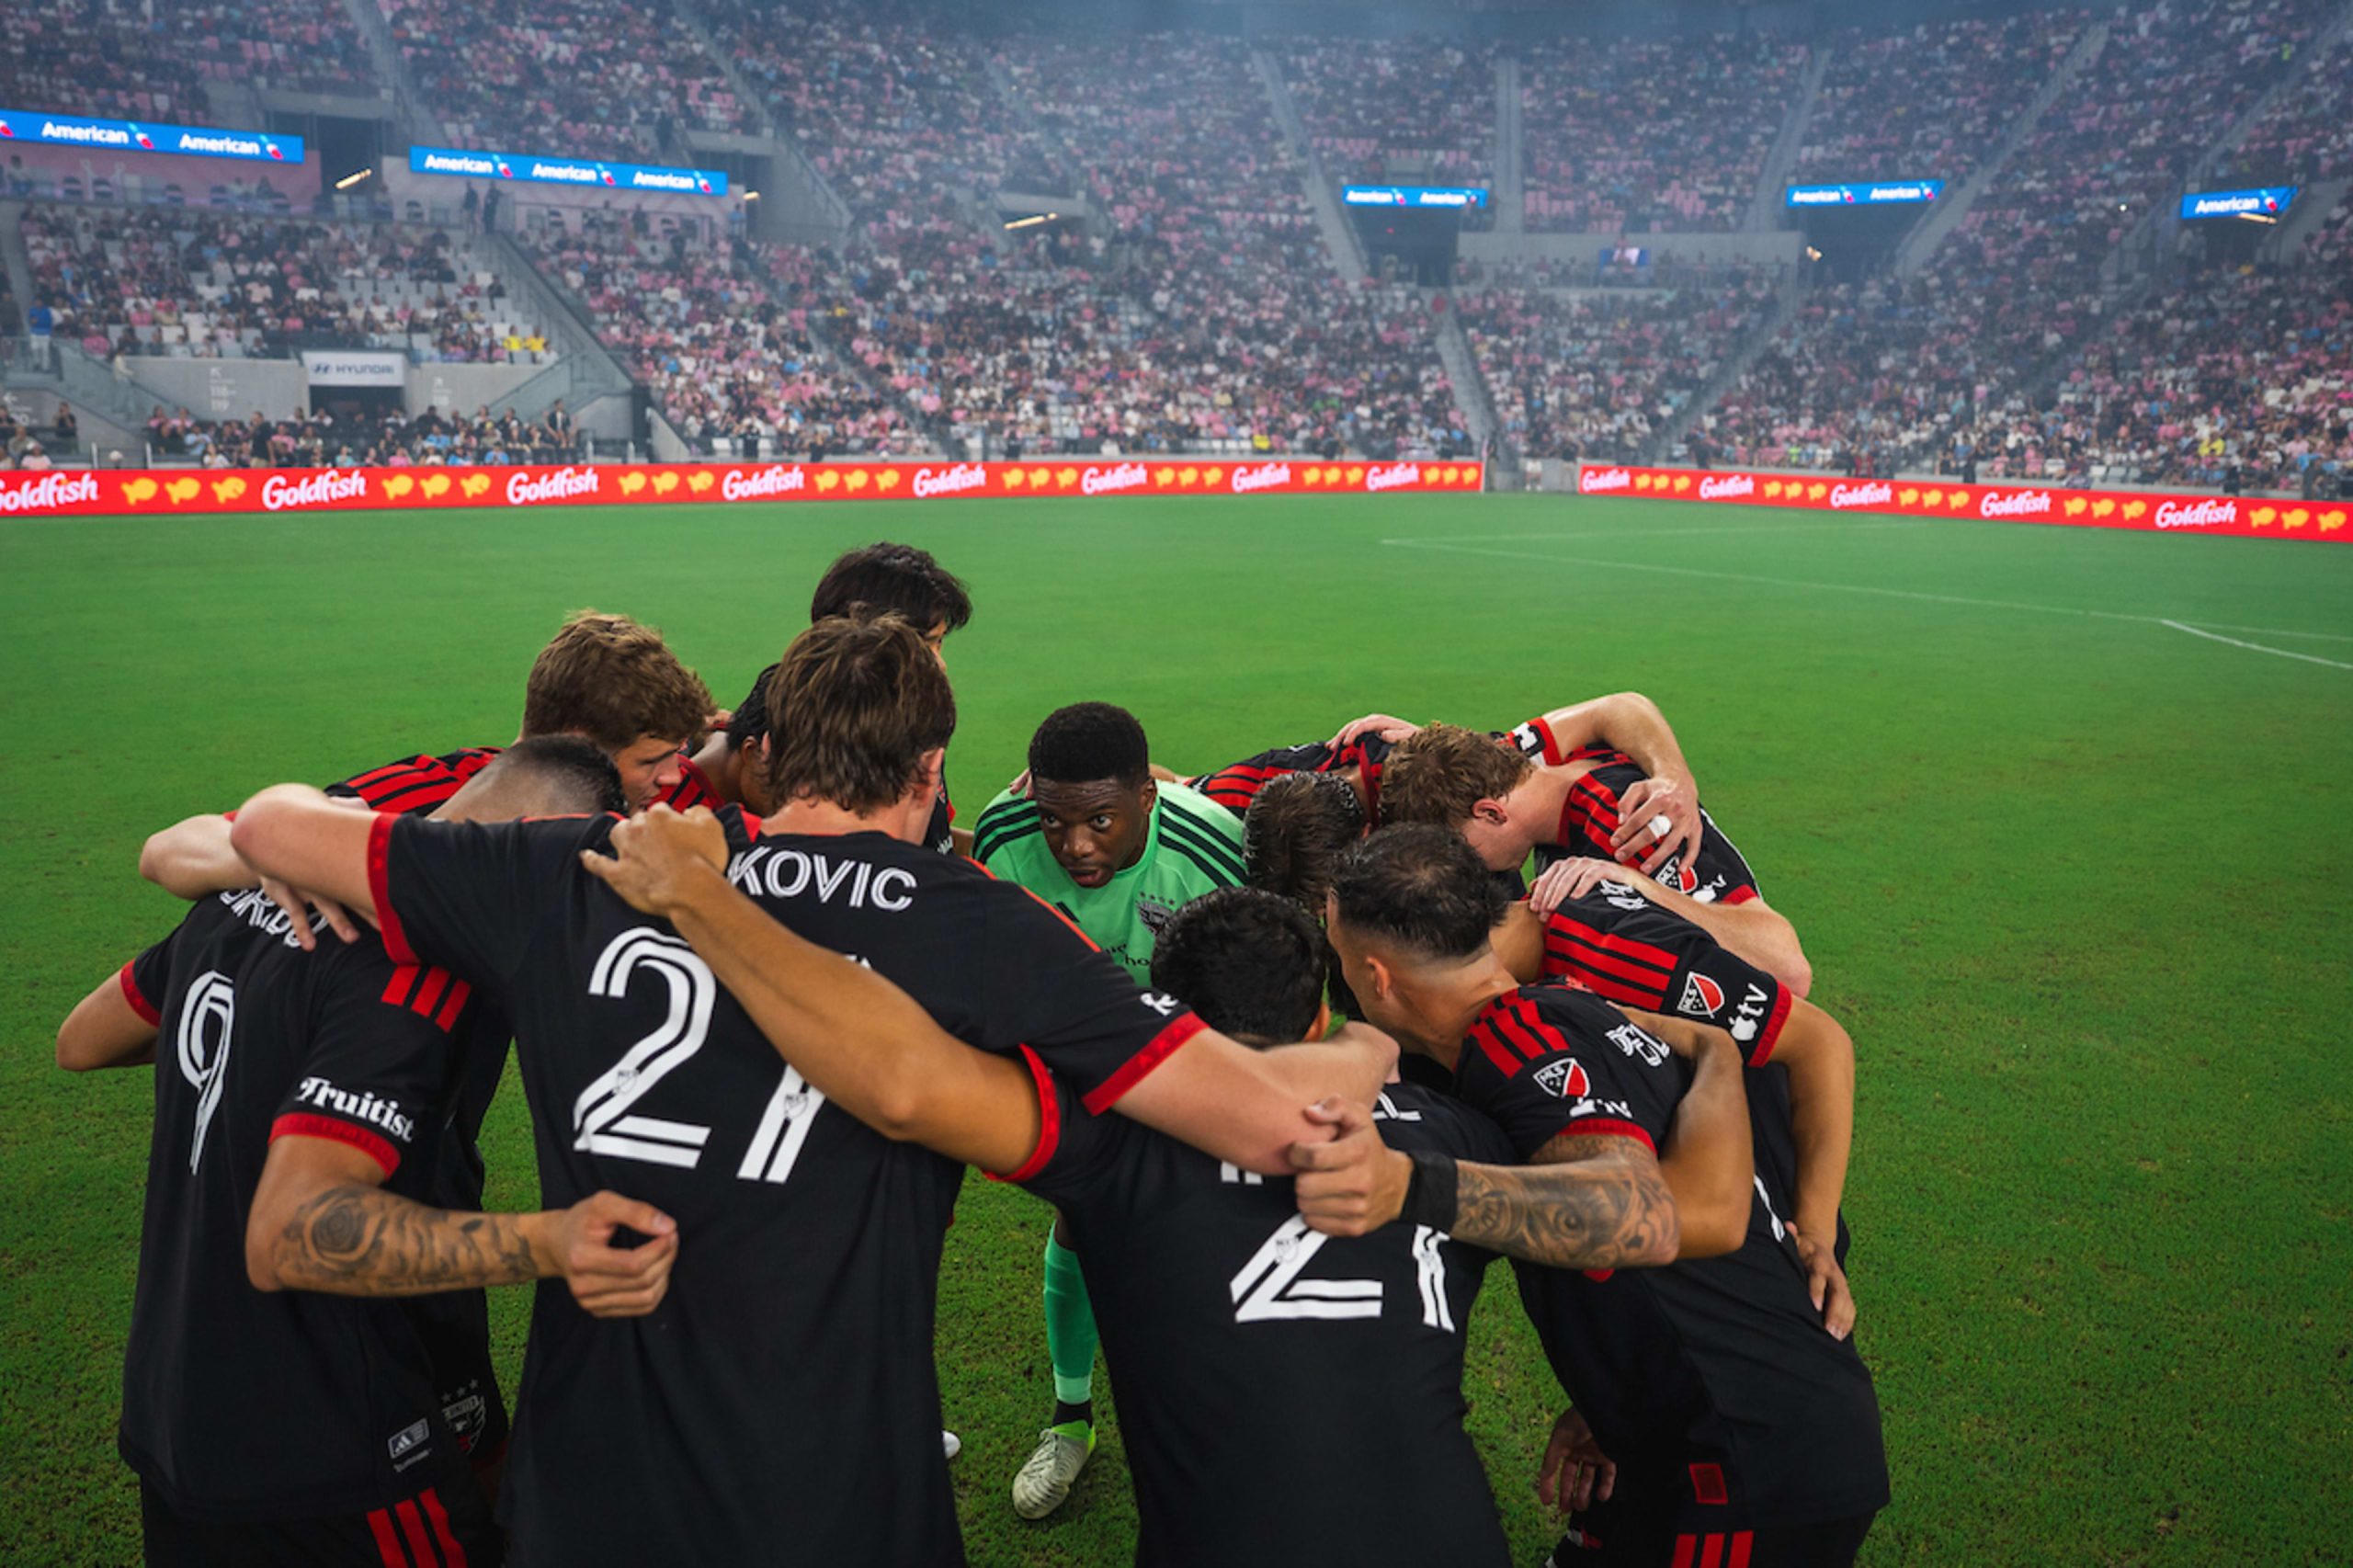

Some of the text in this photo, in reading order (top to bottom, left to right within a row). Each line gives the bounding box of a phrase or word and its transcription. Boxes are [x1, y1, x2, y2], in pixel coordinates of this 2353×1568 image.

[41, 121, 260, 155] American American
[425, 153, 695, 190] American American American
[2195, 197, 2260, 214] American
[336, 364, 394, 376] HYUNDAI
[262, 470, 368, 510] Goldfish
[506, 468, 598, 505] Goldfish
[722, 465, 805, 501] Goldfish
[913, 464, 986, 497] Goldfish
[1082, 462, 1147, 494] Goldfish
[1232, 462, 1290, 493] Goldfish
[1366, 463, 1419, 491] Goldfish
[1582, 469, 2236, 529] Goldfish Goldfish Goldfish Goldfish Goldfish
[1737, 983, 1768, 1017] tv
[177, 970, 234, 1176] 9
